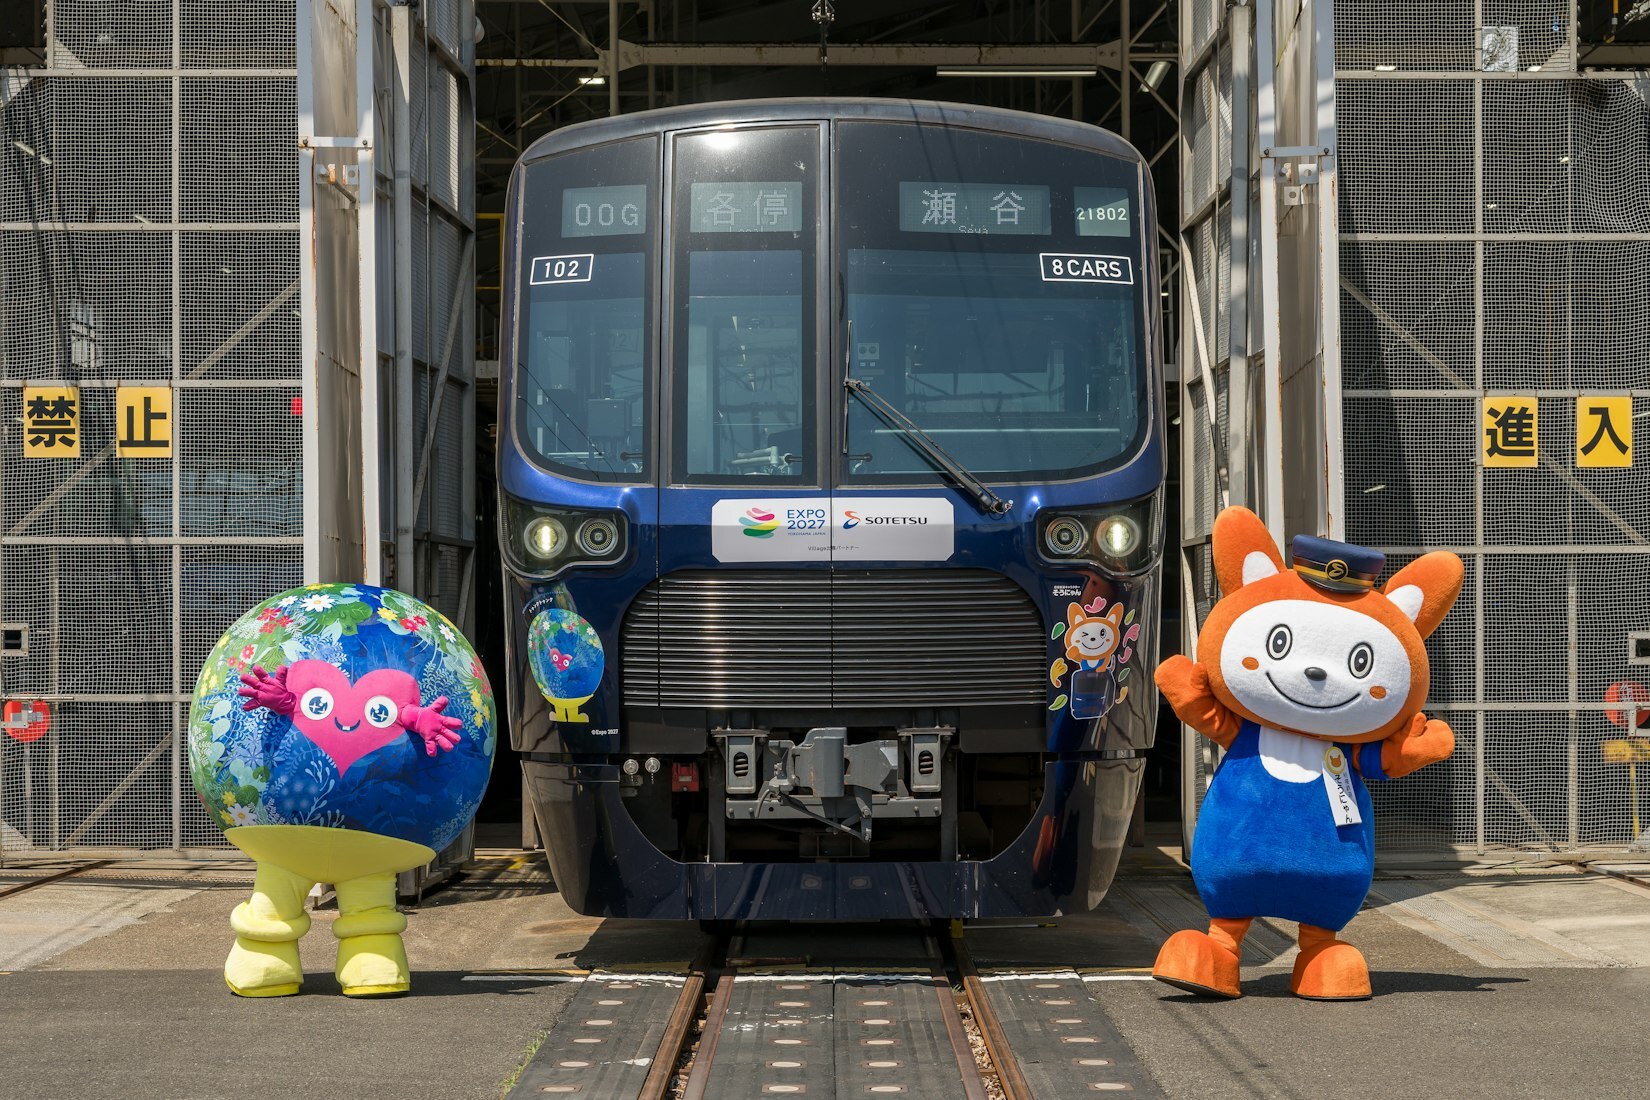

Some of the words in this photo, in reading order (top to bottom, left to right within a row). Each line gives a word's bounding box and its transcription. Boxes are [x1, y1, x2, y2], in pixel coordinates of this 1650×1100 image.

[706, 190, 788, 226] 各停
[921, 189, 1026, 225] 瀬谷
[1076, 207, 1127, 221] 21802
[544, 260, 579, 278] 102
[1052, 259, 1063, 276] 8
[1067, 260, 1122, 278] CARS
[787, 508, 826, 519] EXPO
[865, 516, 928, 525] SOTETSU
[787, 519, 826, 530] 2027
[1052, 589, 1082, 597] そうにゃん
